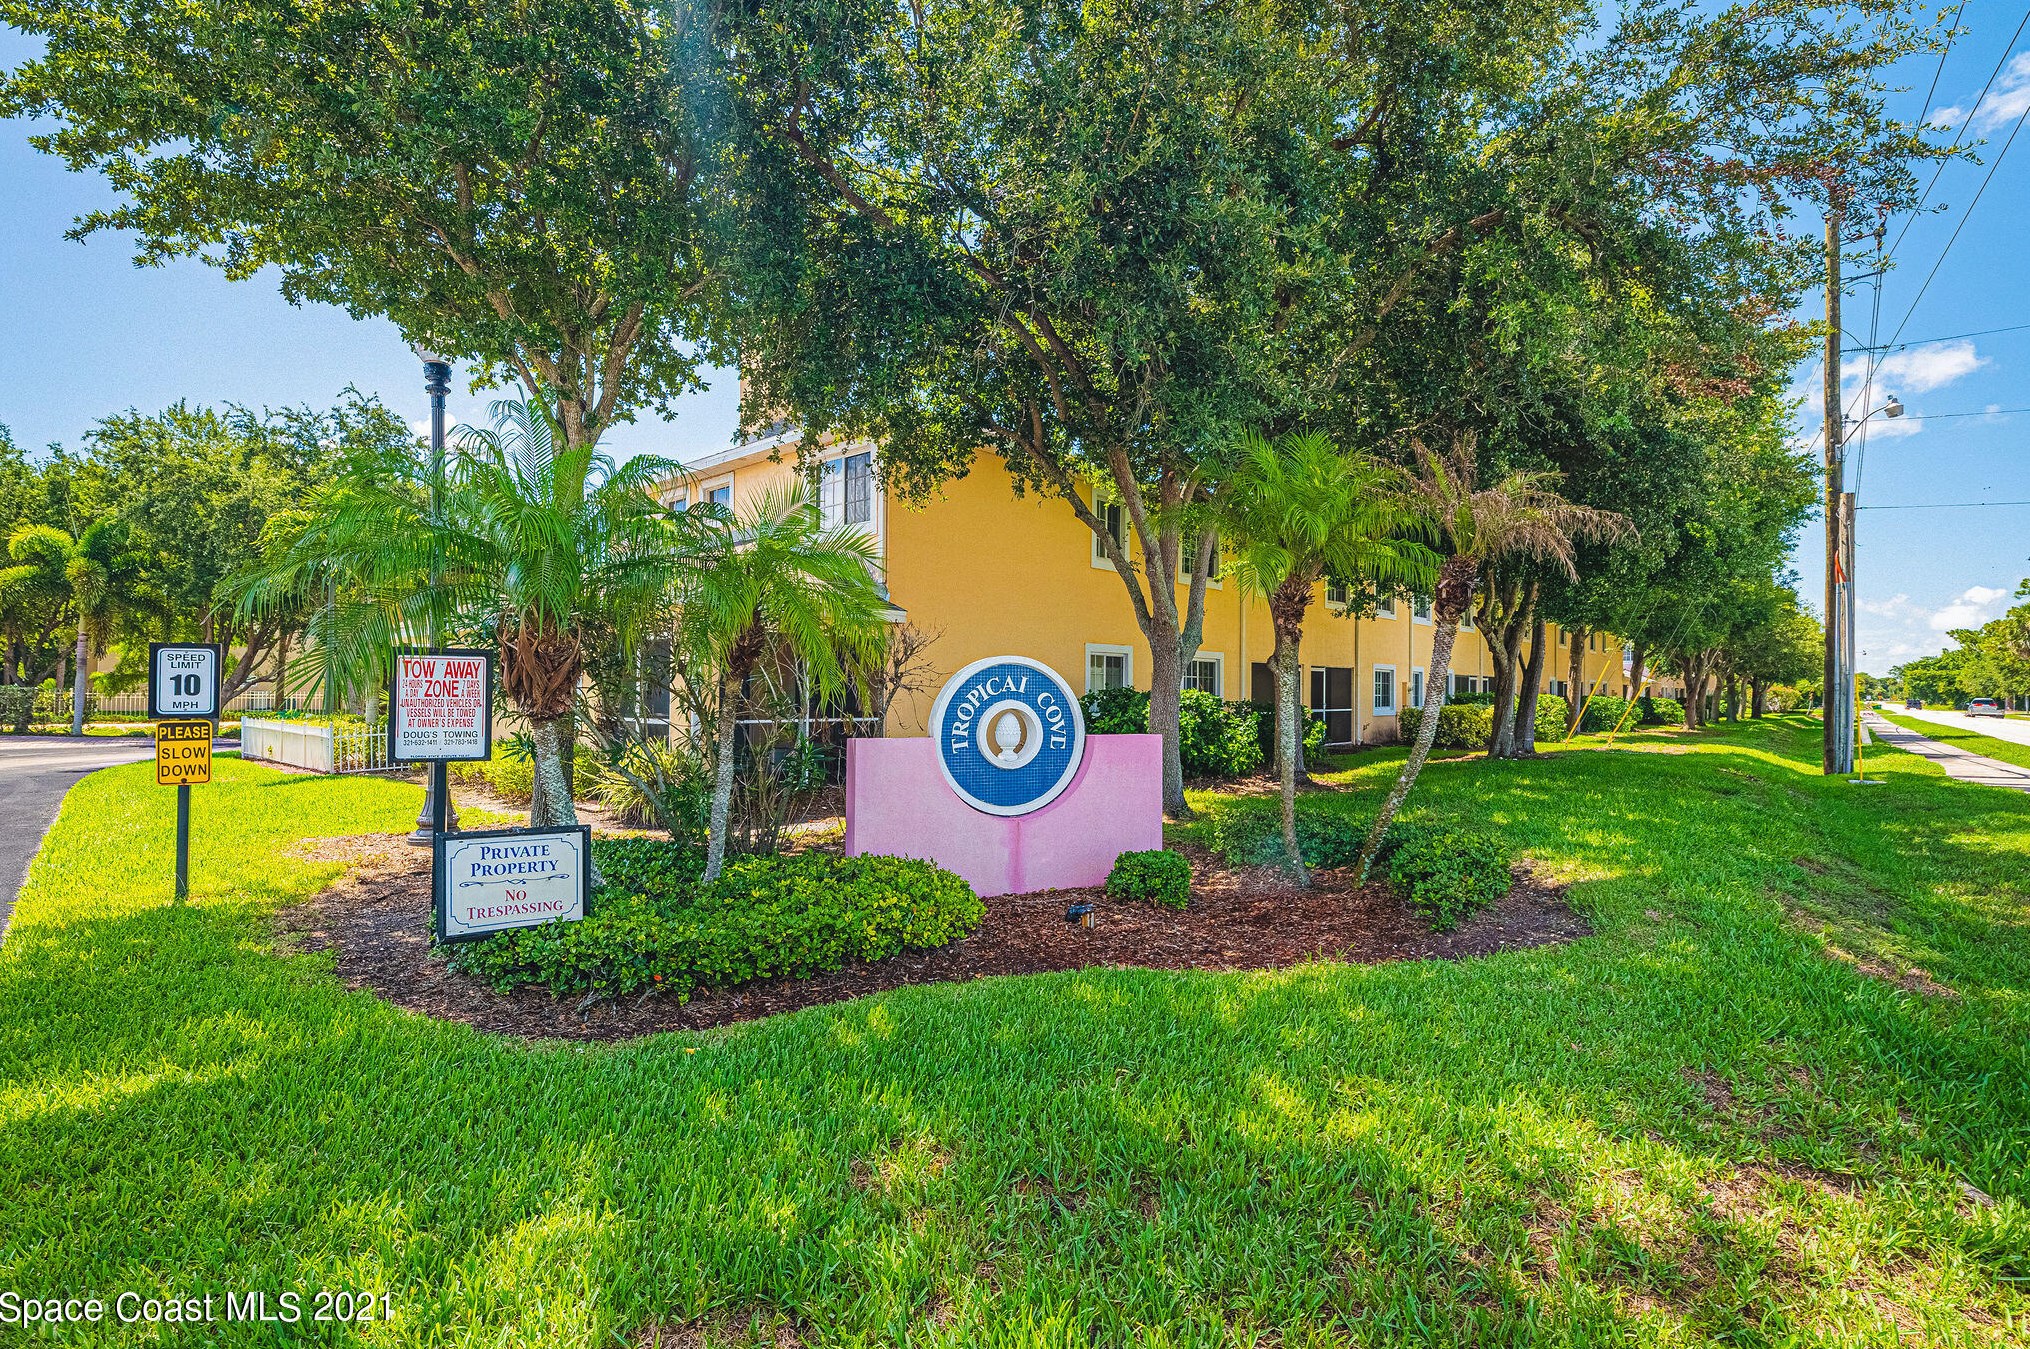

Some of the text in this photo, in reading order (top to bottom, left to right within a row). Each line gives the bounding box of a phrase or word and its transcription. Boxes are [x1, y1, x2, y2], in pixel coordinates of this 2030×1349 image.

[167, 653, 206, 661] SPEED
[171, 661, 201, 669] LIMIT
[403, 660, 481, 679] TOW AWAY
[170, 674, 201, 696] 10
[402, 679, 424, 688] 24 HOURS
[462, 680, 480, 689] 7 DAYS
[405, 689, 420, 697] A DAY
[424, 680, 460, 698] ZONE
[461, 689, 480, 698] A WEEK
[172, 701, 199, 709] MPH
[402, 699, 481, 707] UNAUTHORIZED VEHICLES OR
[406, 708, 476, 717] VESSELS WILL BE TOWED
[408, 719, 474, 728] AT OWNER'S EXPENSE
[160, 726, 209, 739] PLEASE
[403, 731, 438, 739] DOUG'S
[161, 747, 206, 759] SLOW
[161, 764, 207, 777] DOWN
[480, 844, 550, 860] PRIVATE
[471, 860, 559, 877] PROPERTY
[505, 889, 527, 901] NO
[467, 900, 563, 920] TRESPASSING
